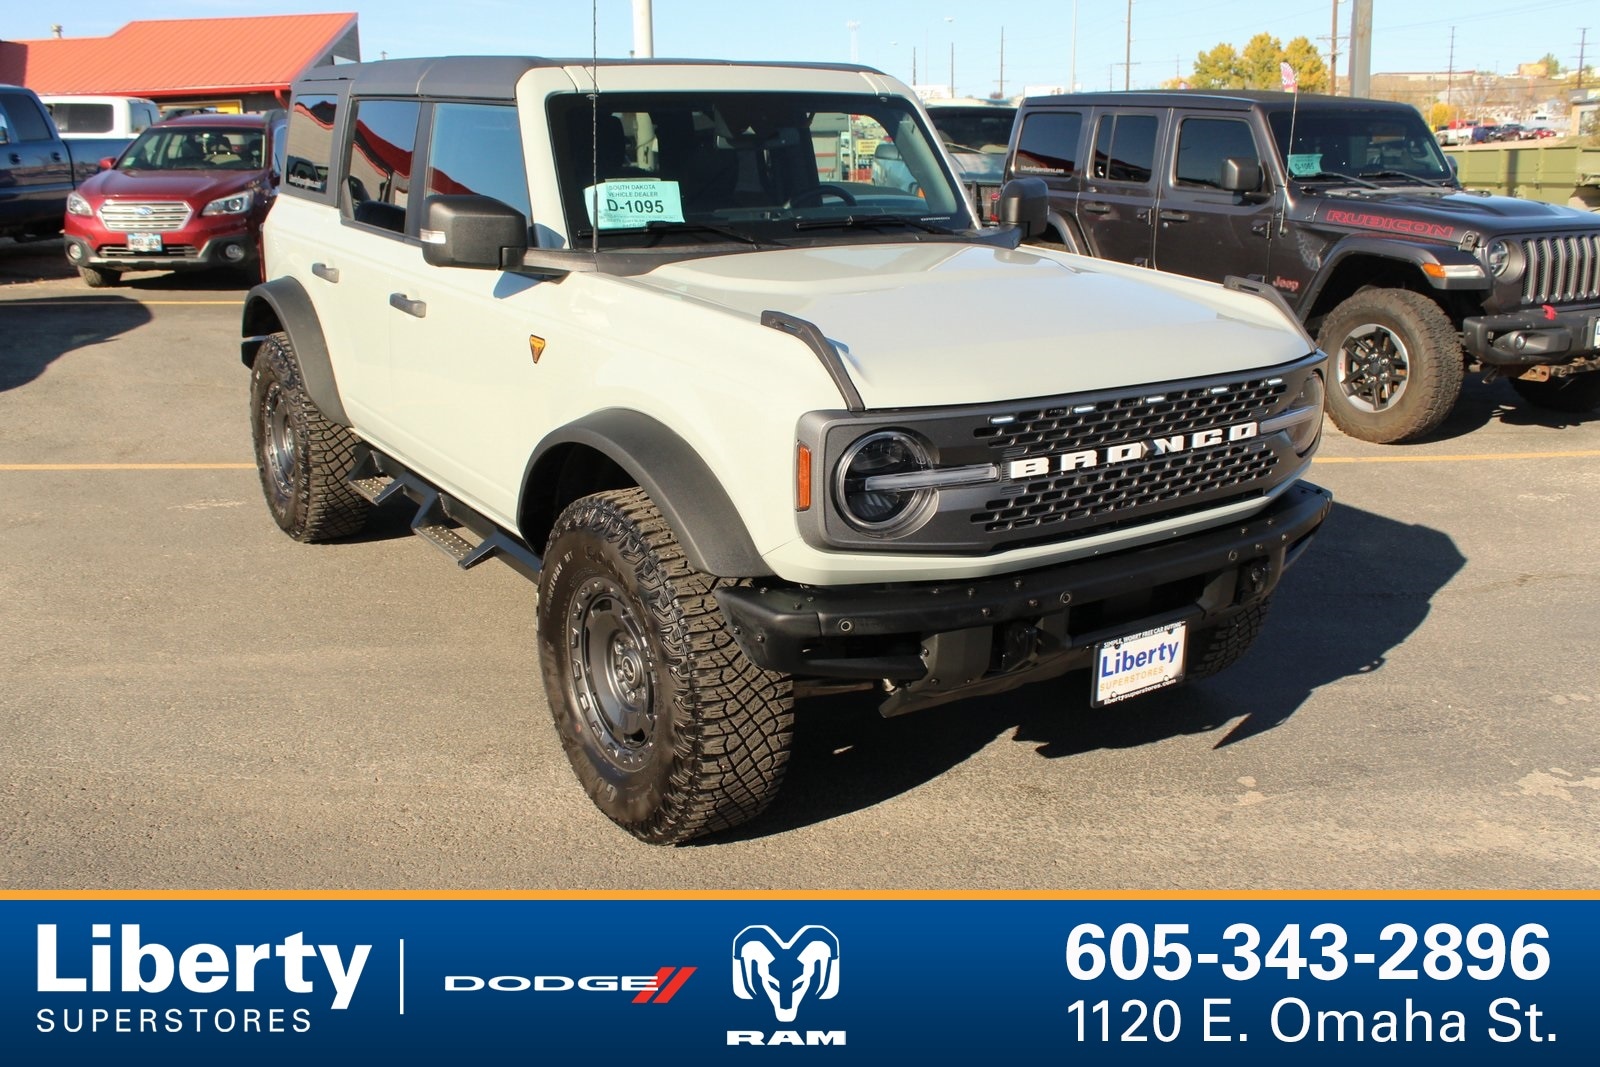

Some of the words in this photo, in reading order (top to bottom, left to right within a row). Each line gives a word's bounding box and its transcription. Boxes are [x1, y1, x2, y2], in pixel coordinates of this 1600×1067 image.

[606, 198, 664, 214] D-1095
[1326, 210, 1454, 238] RUBICON
[1272, 276, 1299, 291] Jeep
[1010, 422, 1258, 480] BRONCO
[1101, 641, 1179, 678] Liberty
[1100, 665, 1164, 692] SUPERSTORES
